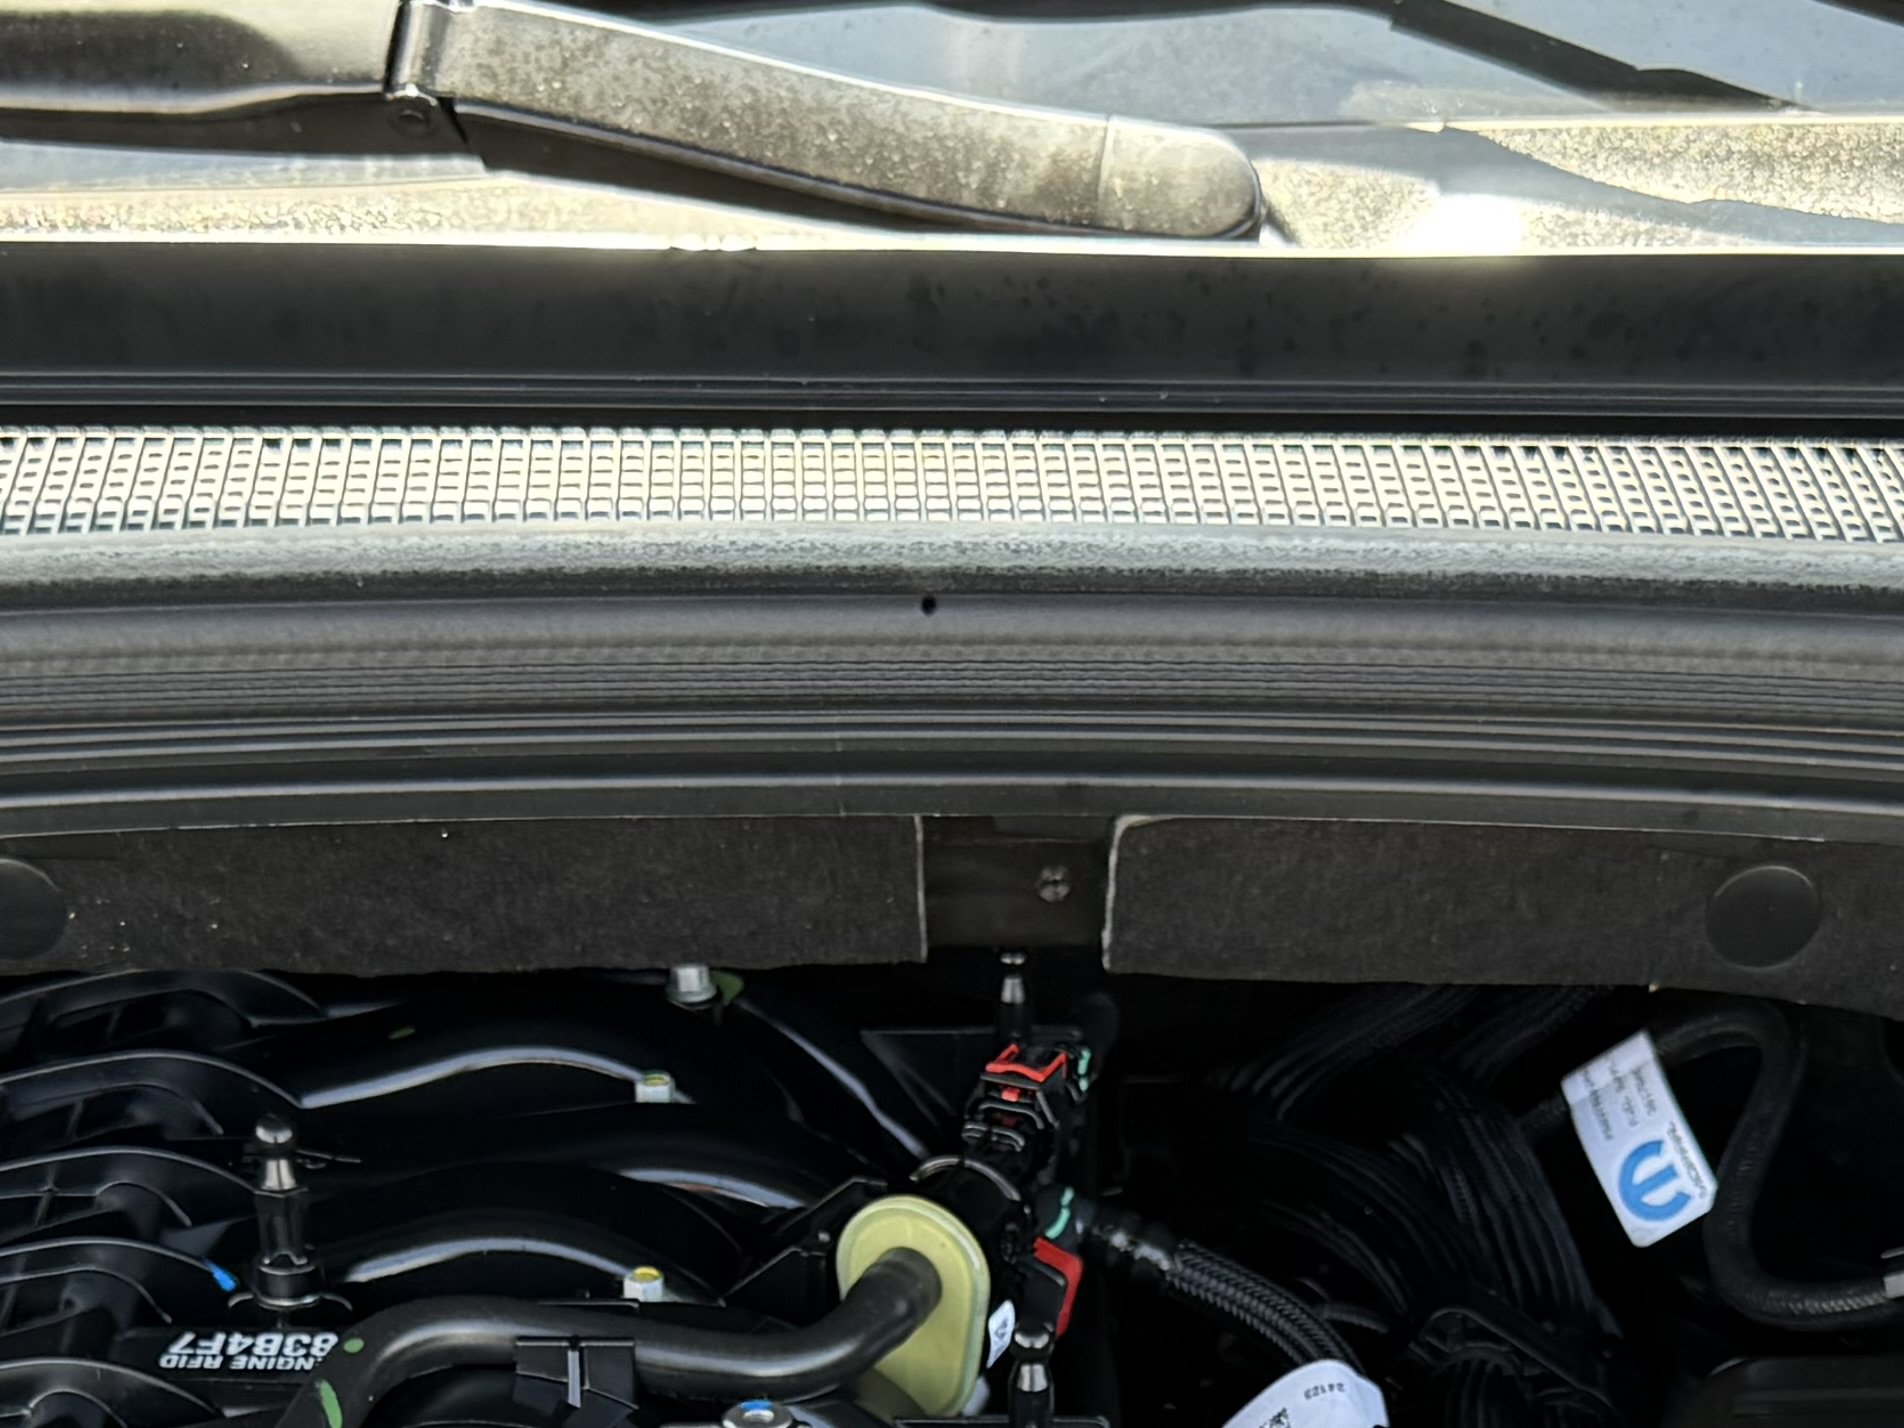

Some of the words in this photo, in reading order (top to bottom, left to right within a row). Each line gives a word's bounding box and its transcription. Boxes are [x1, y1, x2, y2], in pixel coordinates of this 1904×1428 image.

[167, 1331, 339, 1357] 83B4F7
[159, 1354, 222, 1370] RFID
[229, 1355, 323, 1370] NGINE
